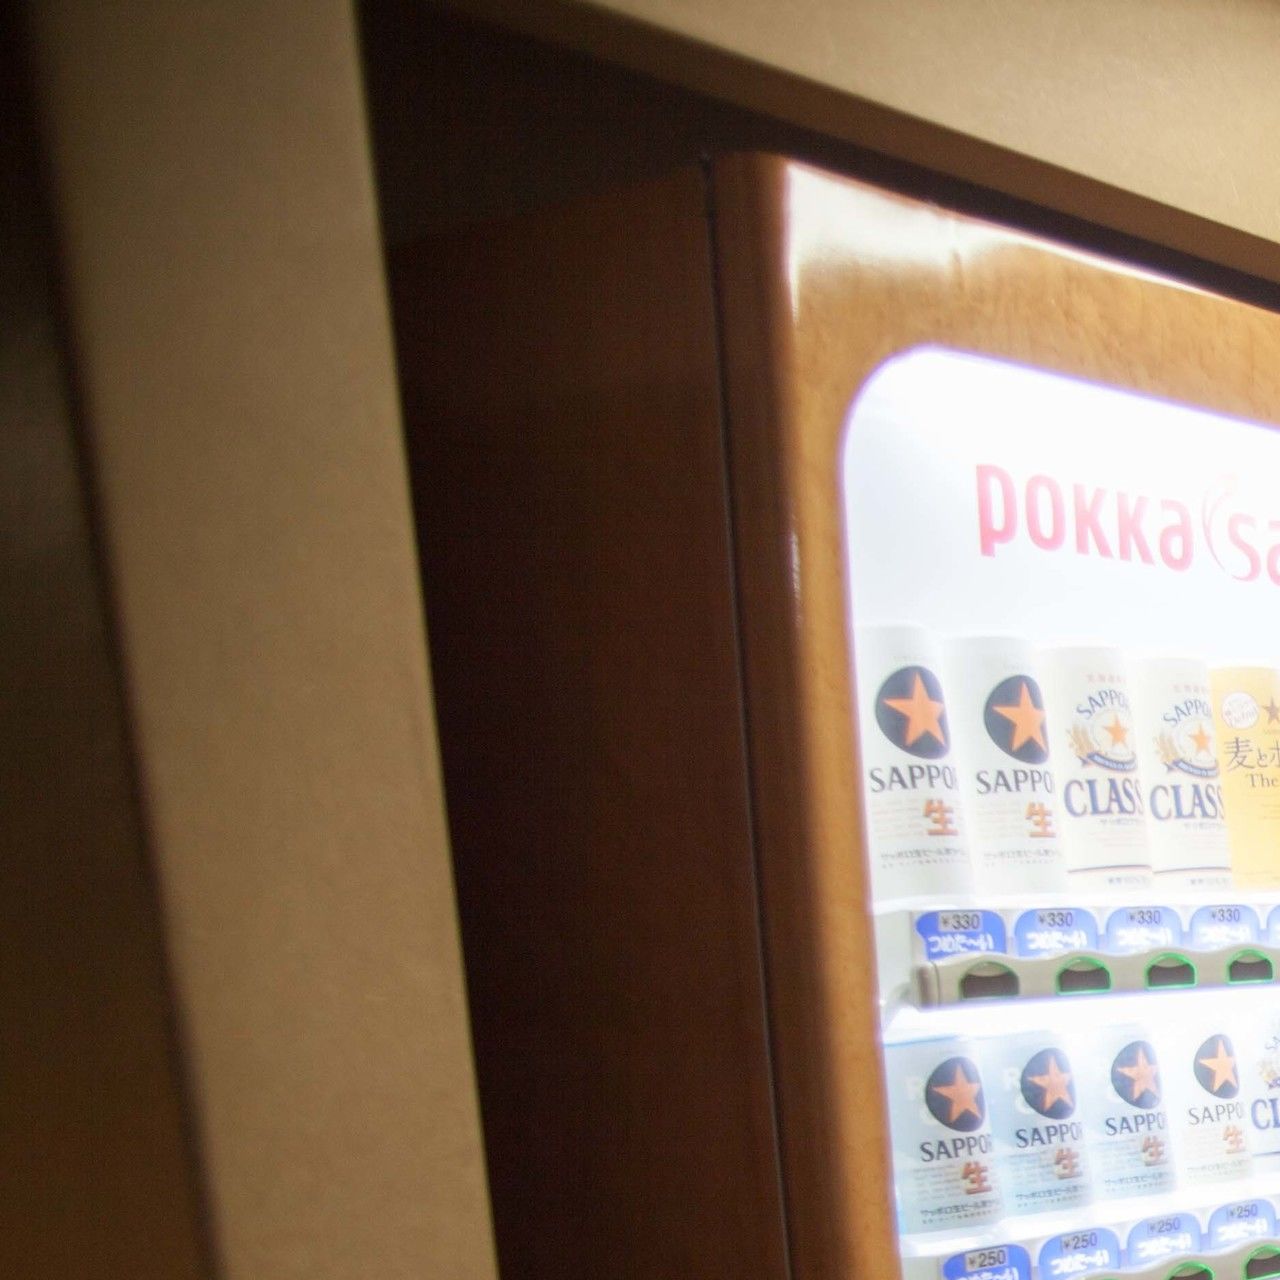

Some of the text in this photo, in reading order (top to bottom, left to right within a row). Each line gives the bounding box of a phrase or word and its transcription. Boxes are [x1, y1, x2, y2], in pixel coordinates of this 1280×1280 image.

[922, 798, 959, 836] 生
[1024, 801, 1057, 838] 生
[942, 912, 980, 930] ¥330
[1038, 910, 1074, 928] ¥330
[1128, 908, 1162, 926] ¥330
[1210, 906, 1241, 922] ¥330
[1140, 1135, 1169, 1168] 生
[1052, 1146, 1084, 1180] 生
[959, 1160, 993, 1196] 生
[1228, 1203, 1259, 1219] ¥250
[1150, 1216, 1181, 1234] ¥250
[1063, 1231, 1098, 1250] ¥250
[967, 1249, 1007, 1268] ¥250
